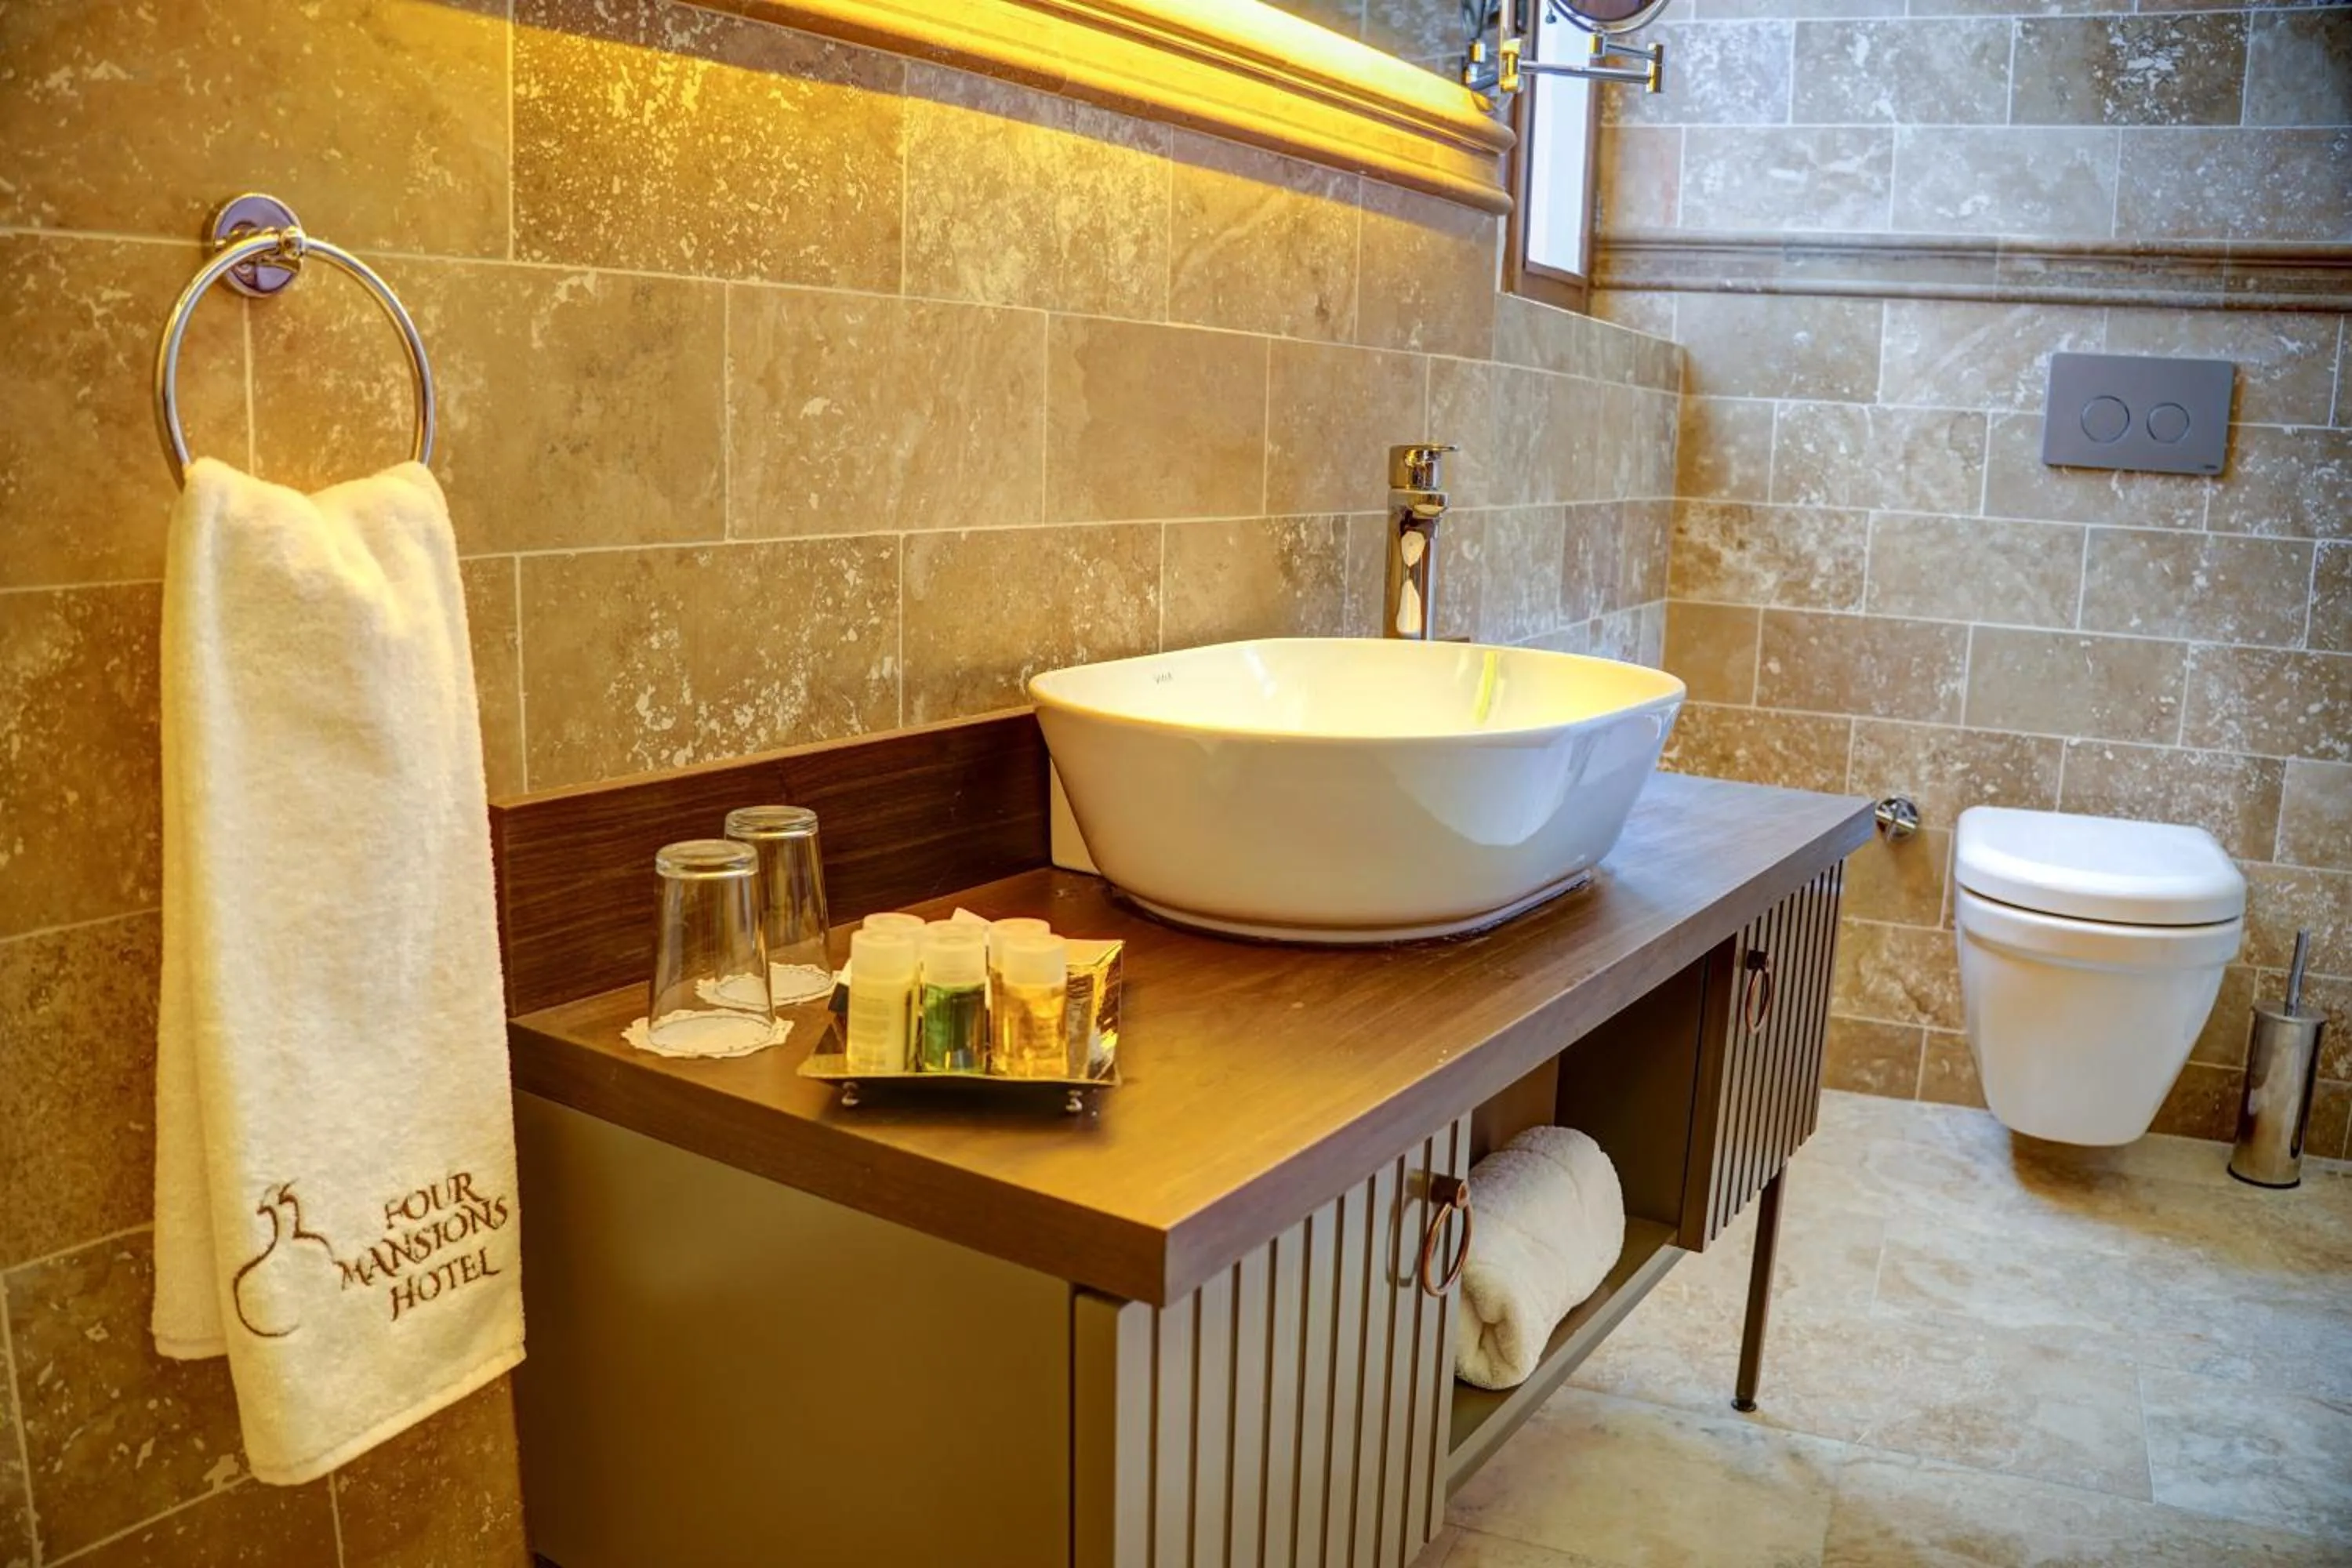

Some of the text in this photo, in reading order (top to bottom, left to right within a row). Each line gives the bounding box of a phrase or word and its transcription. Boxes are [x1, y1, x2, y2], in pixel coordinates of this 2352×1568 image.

[385, 1172, 485, 1229] FOUR
[334, 1197, 508, 1290] MANSIONS
[391, 1248, 501, 1320] HOTEL
